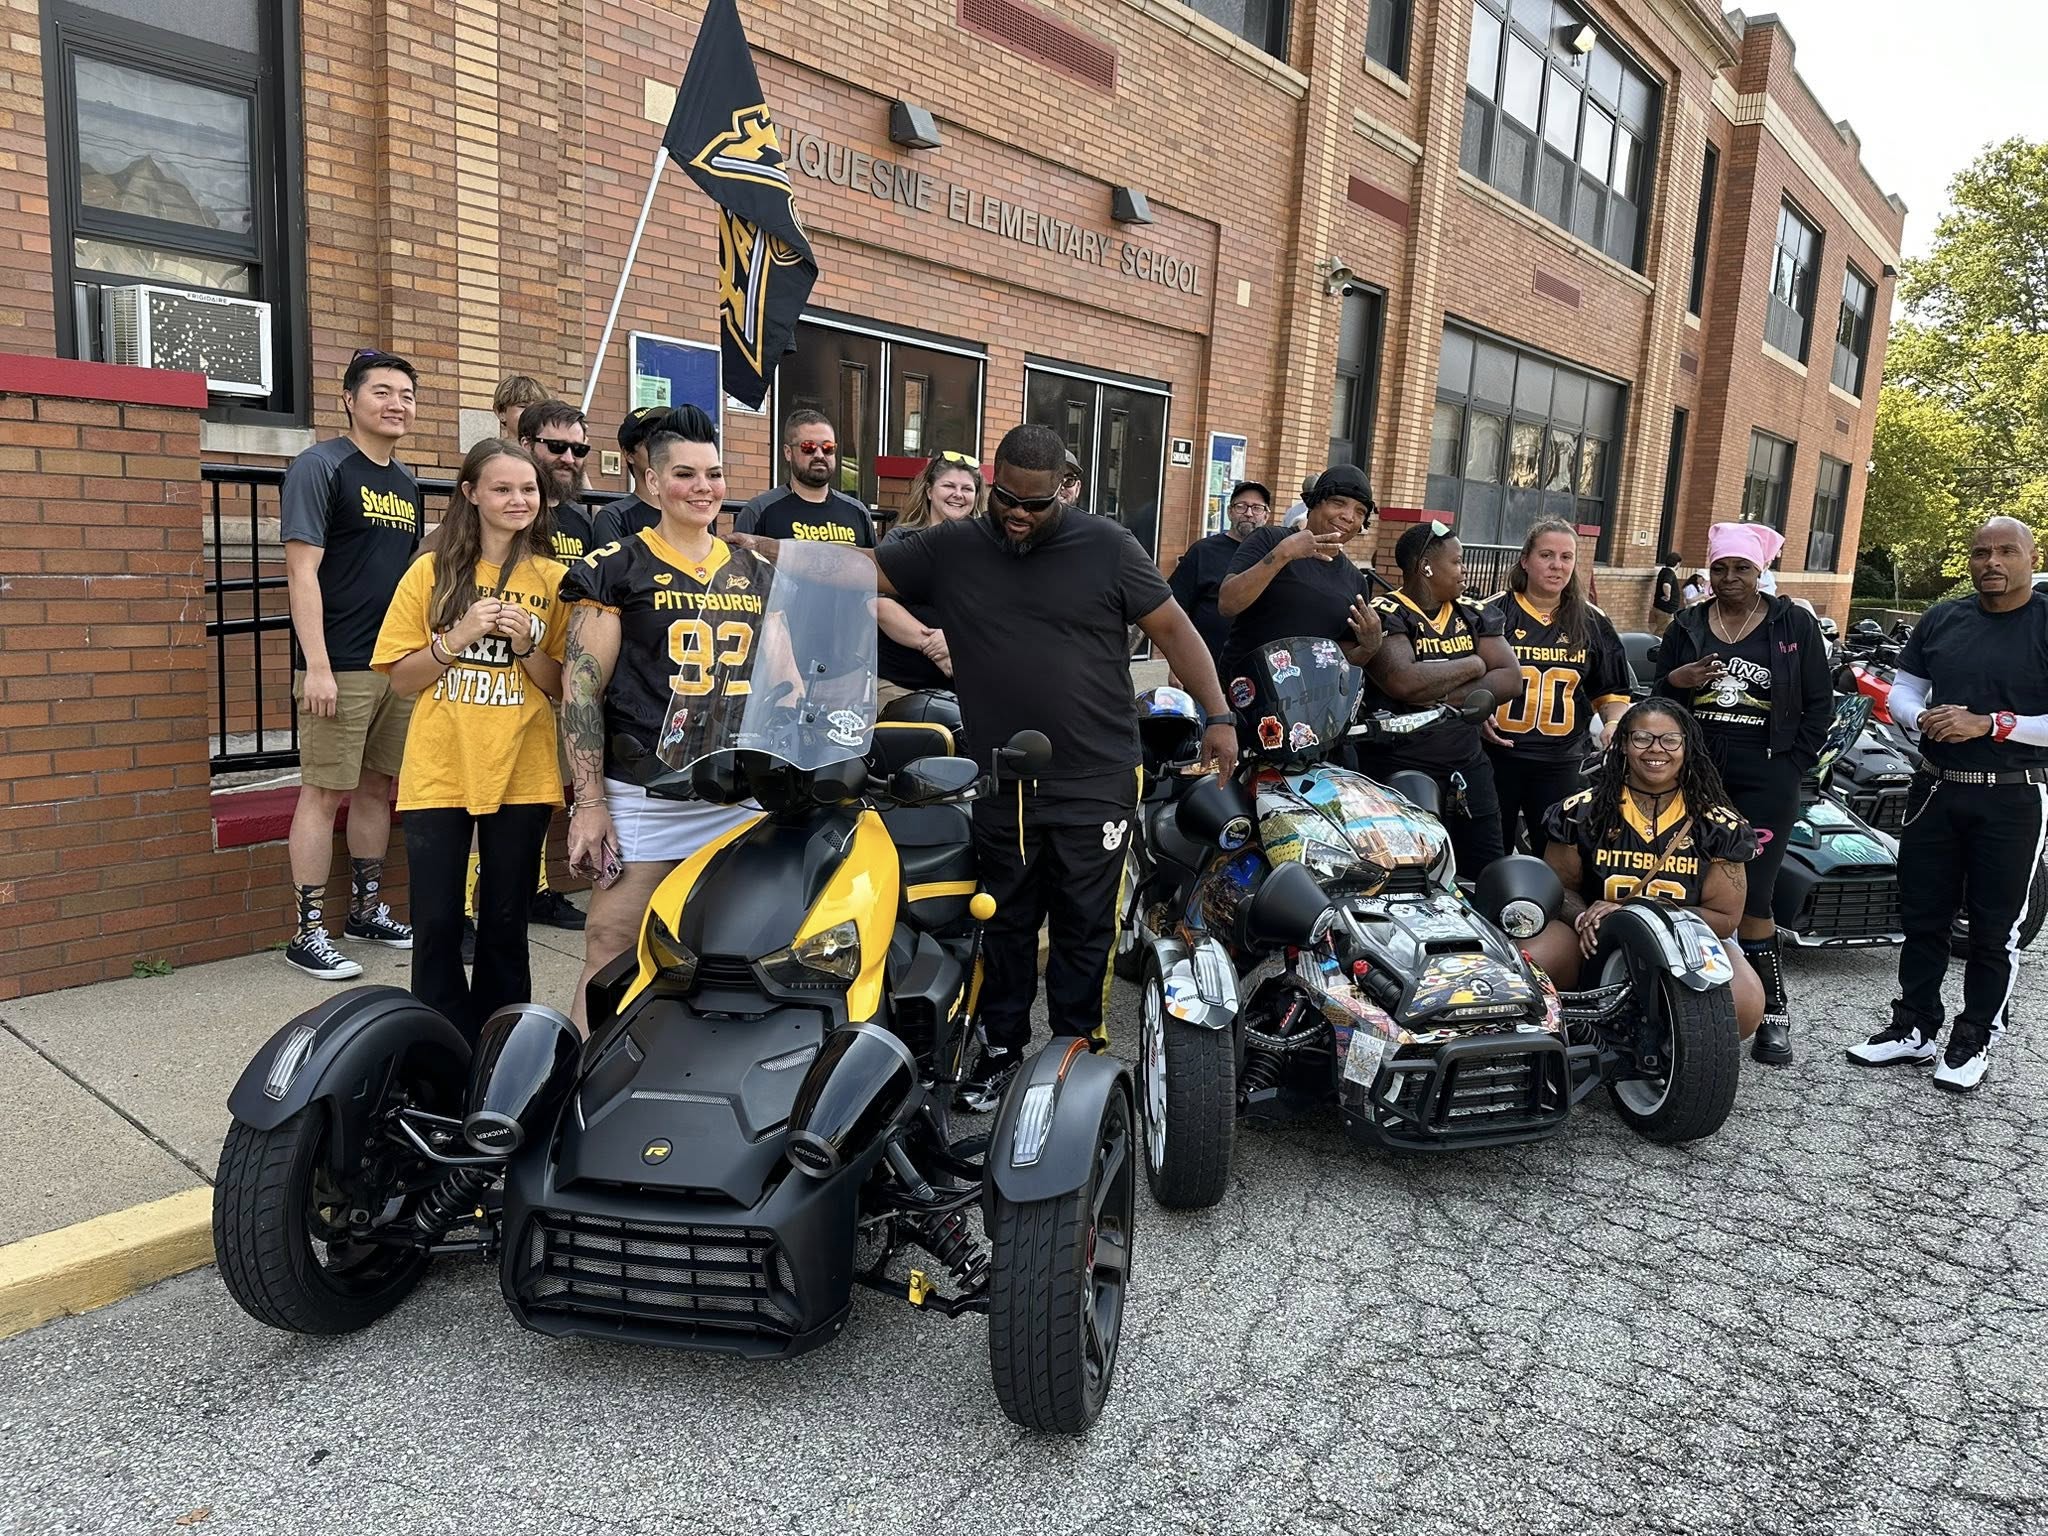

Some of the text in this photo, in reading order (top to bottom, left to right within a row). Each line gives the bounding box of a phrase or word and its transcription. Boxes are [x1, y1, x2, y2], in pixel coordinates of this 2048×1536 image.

[776, 124, 936, 213] UQUESNE
[948, 183, 1112, 267] ELEMENTARY
[1120, 242, 1203, 297] SCHOOL
[187, 292, 229, 304] FRIGIDAIRE
[361, 485, 416, 521] Steeline
[791, 521, 856, 542] Steeline
[551, 530, 584, 556] eline
[529, 594, 550, 611] OF
[654, 589, 762, 615] PITTSBURGH
[667, 618, 754, 697] 92
[1511, 645, 1586, 664] ITTSBURGH
[1495, 664, 1582, 737] 00
[1717, 686, 1738, 708] 3
[1693, 709, 1767, 727] PITTSBURGH
[475, 1126, 506, 1141] KICKER
